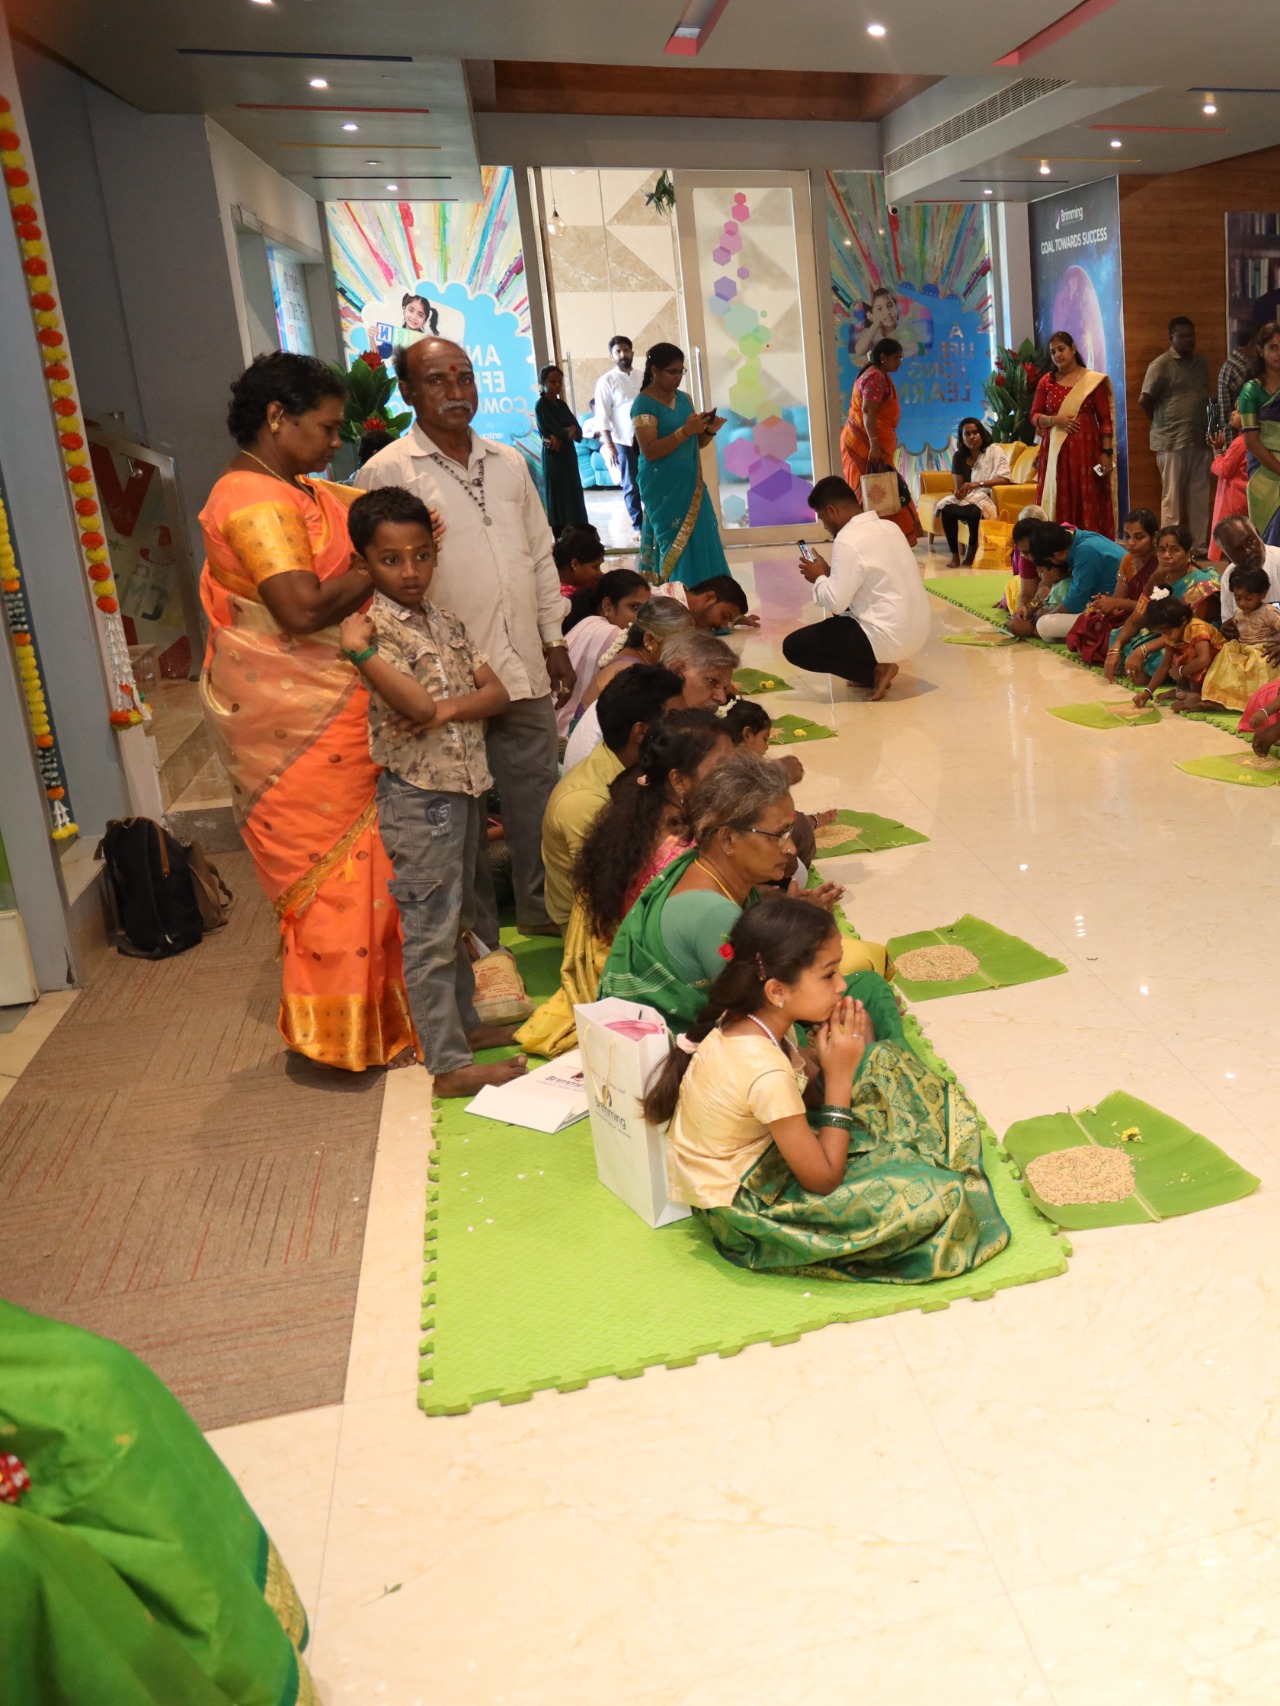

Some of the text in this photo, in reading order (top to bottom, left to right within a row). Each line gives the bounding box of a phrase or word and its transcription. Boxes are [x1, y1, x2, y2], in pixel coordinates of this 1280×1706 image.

[1041, 227, 1108, 255] GOAL TOWARDS SUCCESS
